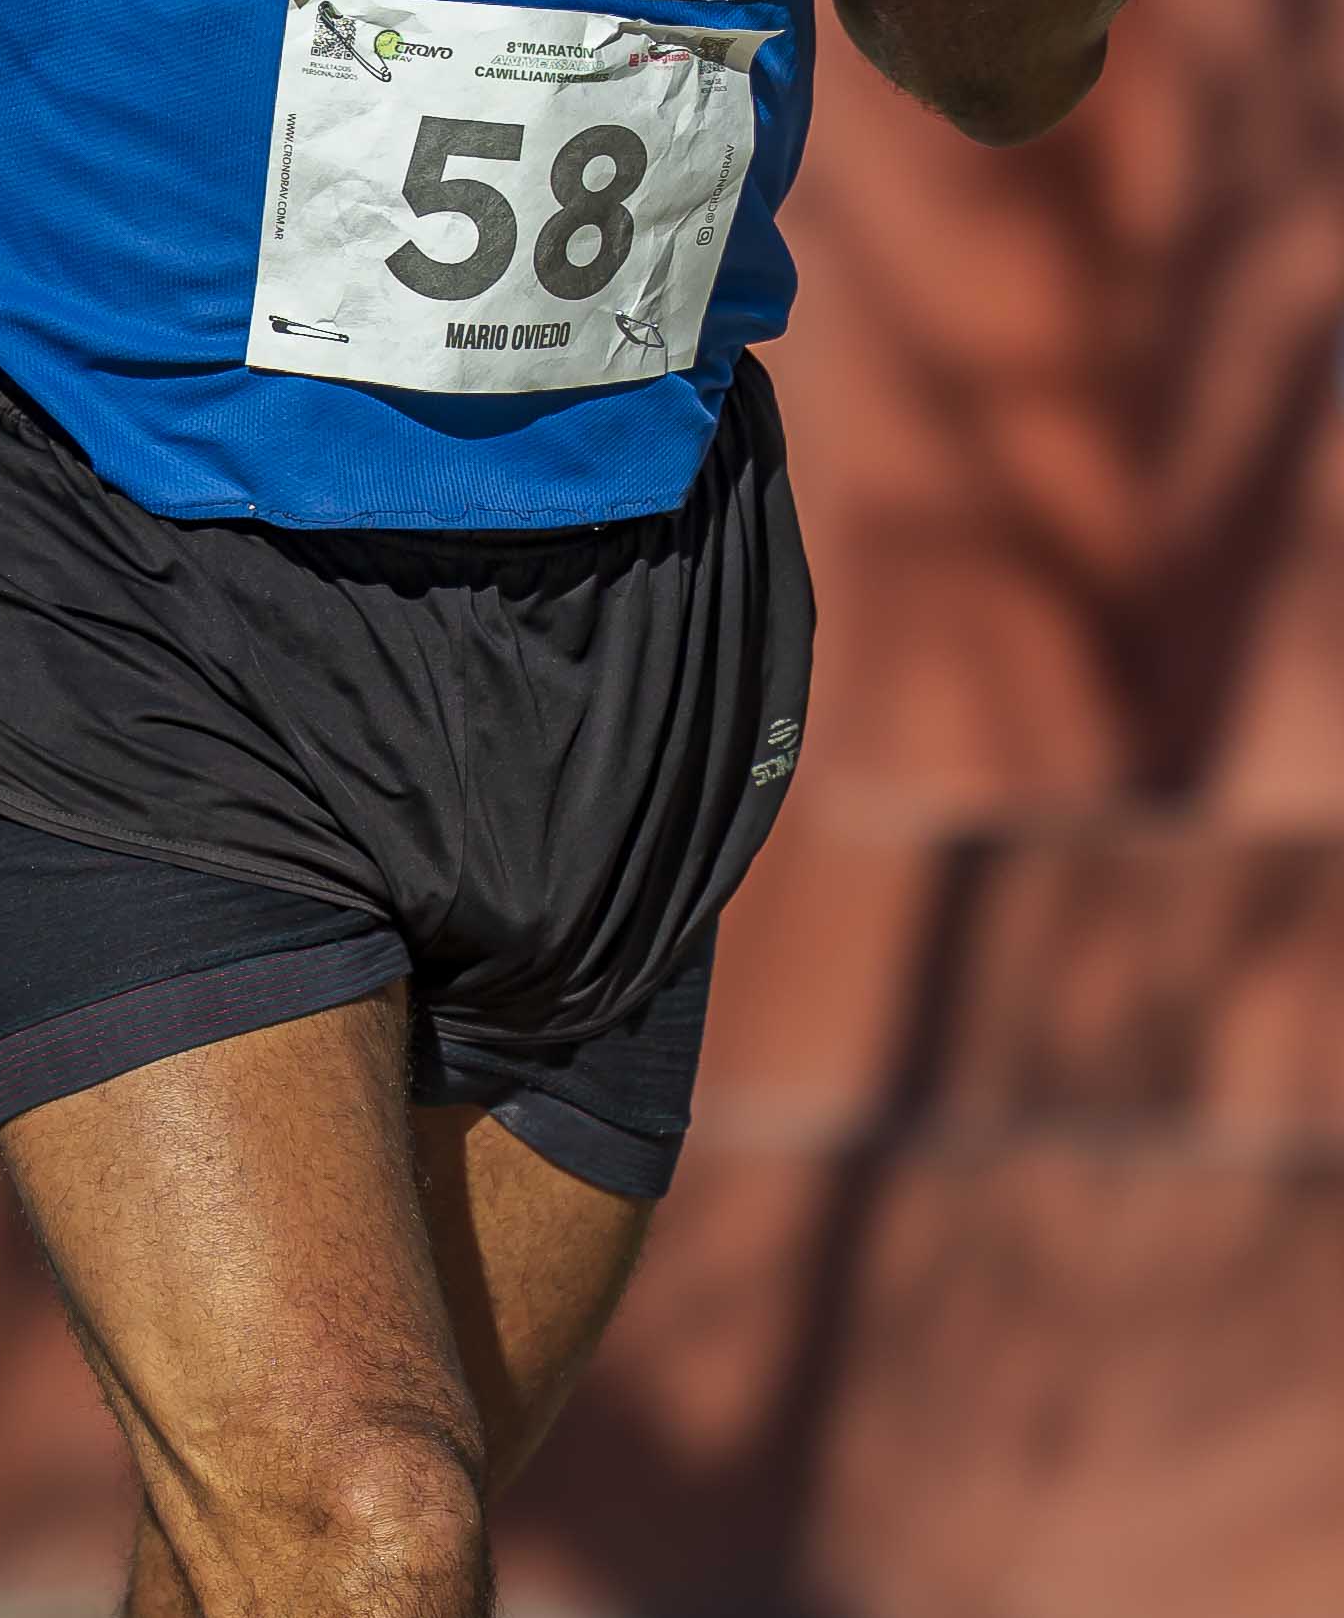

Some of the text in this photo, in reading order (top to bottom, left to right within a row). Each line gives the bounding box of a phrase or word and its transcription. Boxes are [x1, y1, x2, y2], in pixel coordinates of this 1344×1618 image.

[273, 113, 297, 241] WWW.CRONORAV.COM.AR
[384, 115, 648, 301] 58
[444, 321, 571, 351] MARIO OVIEDO
